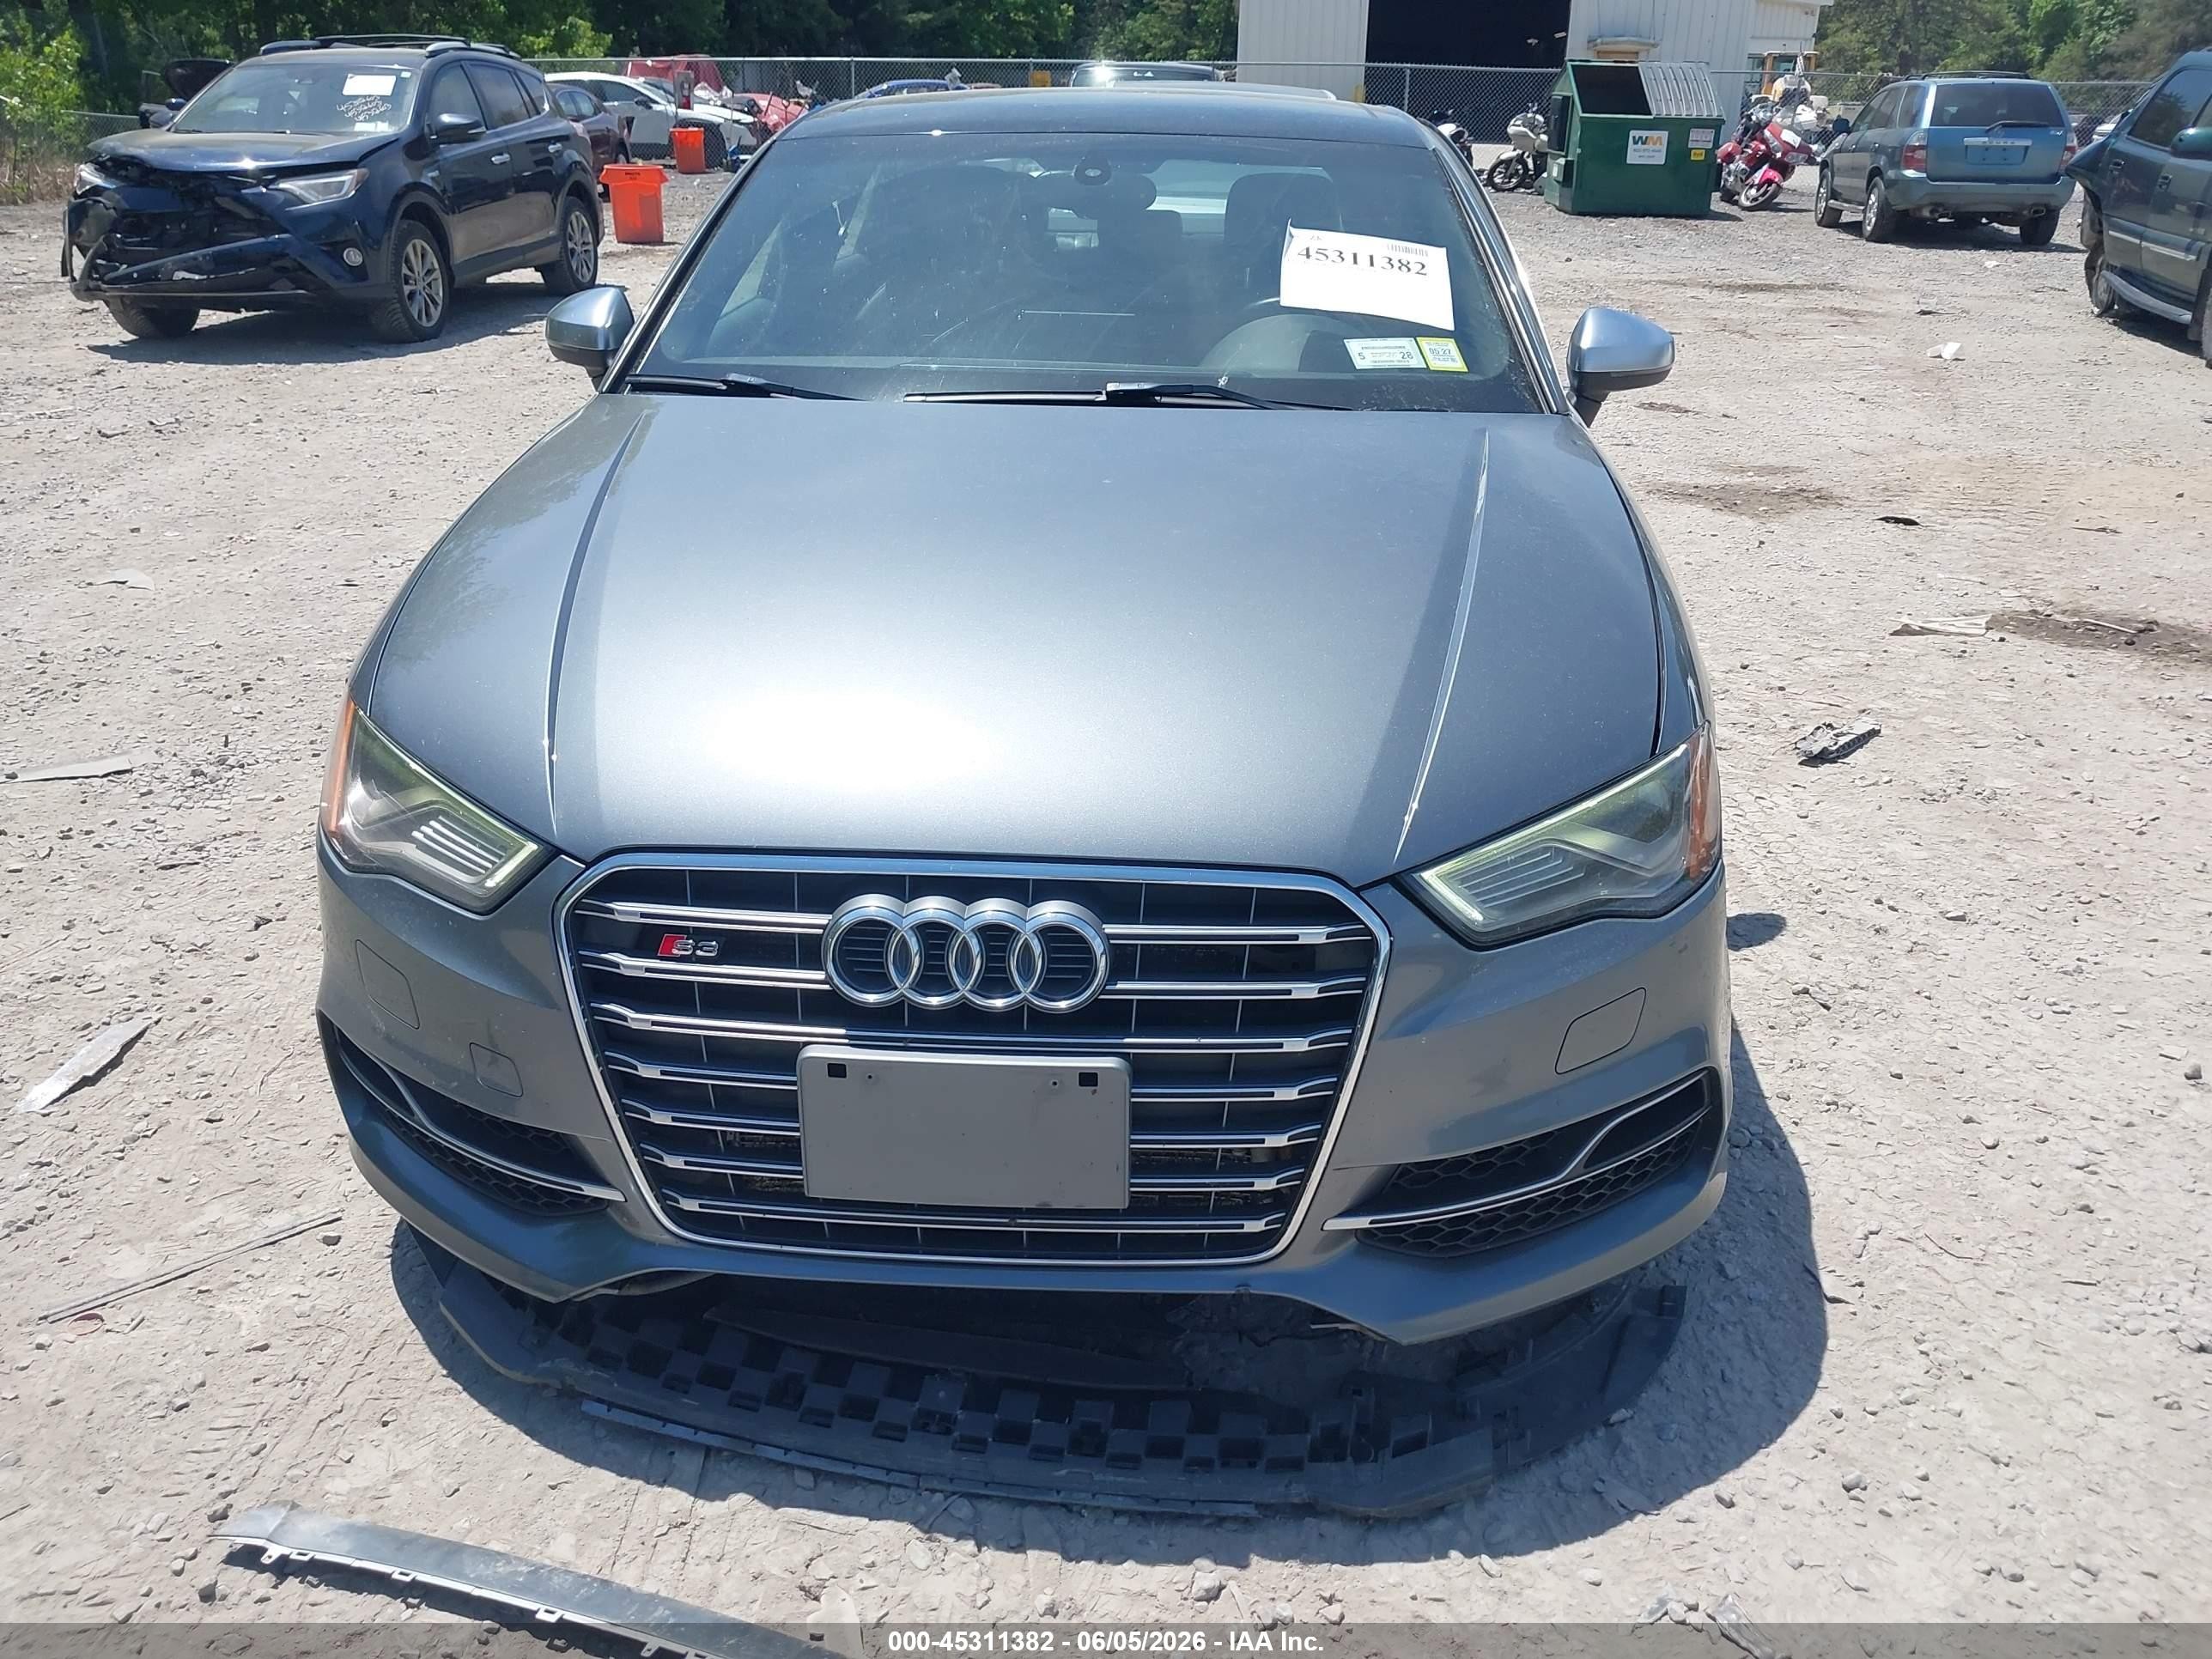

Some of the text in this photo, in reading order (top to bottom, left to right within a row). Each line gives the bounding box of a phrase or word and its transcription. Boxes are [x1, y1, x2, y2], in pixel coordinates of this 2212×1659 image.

[1632, 136, 1662, 145] WM
[1297, 246, 1428, 276] 45311382
[1400, 351, 1414, 360] 28
[672, 939, 719, 957] S3
